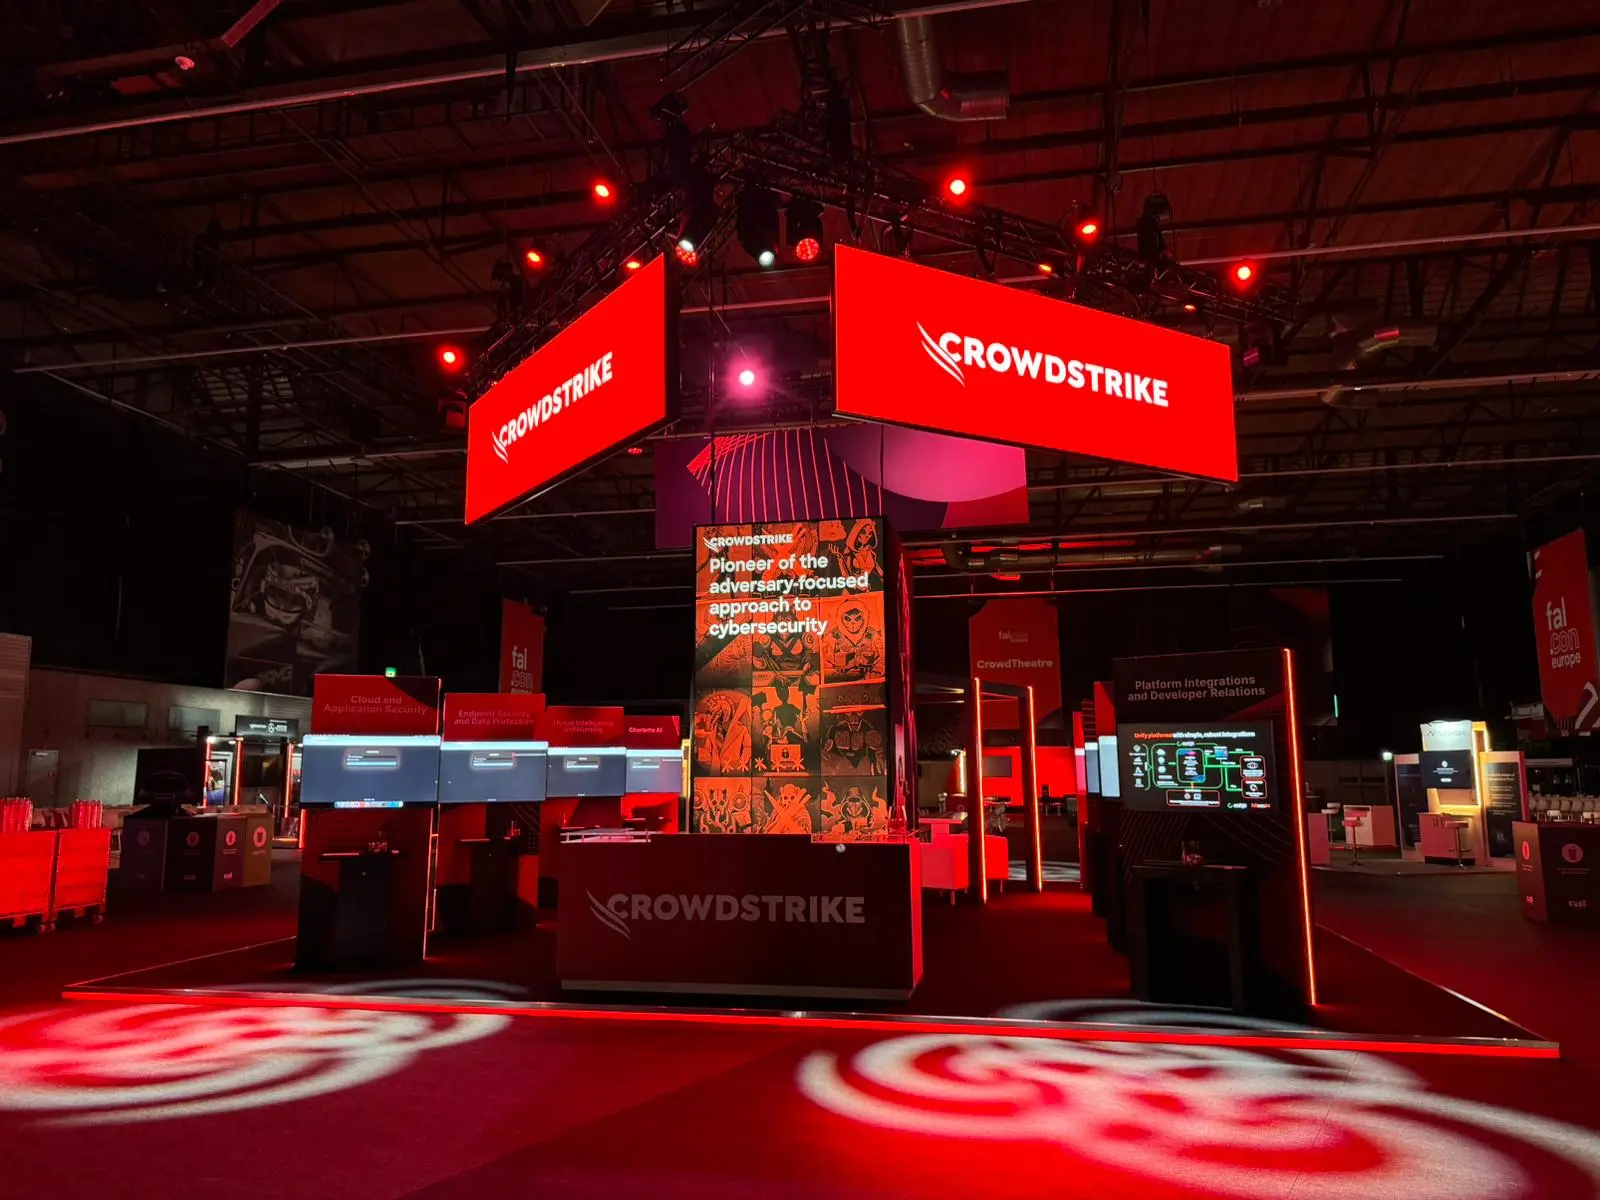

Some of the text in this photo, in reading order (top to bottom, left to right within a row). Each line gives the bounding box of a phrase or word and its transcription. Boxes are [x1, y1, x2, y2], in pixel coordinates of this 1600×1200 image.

[936, 331, 1169, 408] CROWDSTRIKE
[496, 351, 613, 448] CROWDSTRIKE
[710, 533, 793, 547] CROWDSTRIKE
[709, 553, 829, 573] Pioneer of the
[709, 572, 869, 594] adversary-focused
[709, 596, 812, 618] approach to
[1546, 596, 1567, 631] fal
[709, 617, 828, 639] cybersecurity
[511, 645, 528, 670] fal
[976, 658, 1054, 669] CrowdTheatre
[1551, 651, 1581, 669] europe
[1135, 675, 1256, 690] Platform Integrations
[350, 695, 402, 705] Cloud and
[1127, 685, 1266, 702] and Developer Relations
[323, 703, 427, 716] Application Security
[458, 709, 495, 719] Endpoint
[606, 893, 866, 924] CROWDSTRIKE
